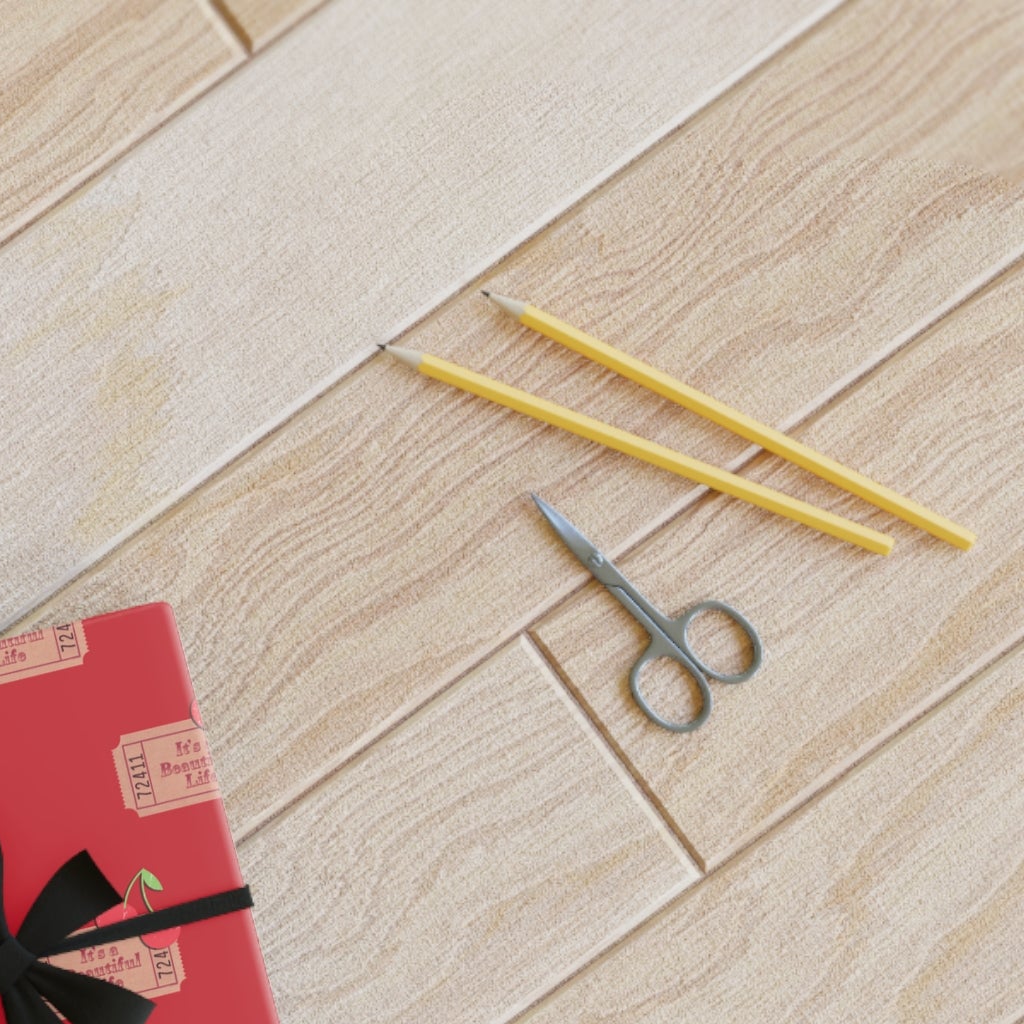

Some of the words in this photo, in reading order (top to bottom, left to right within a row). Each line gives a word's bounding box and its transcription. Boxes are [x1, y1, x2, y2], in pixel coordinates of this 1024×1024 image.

[175, 739, 201, 757] It's
[129, 753, 152, 800] 72411
[185, 769, 217, 789] Life
[80, 946, 106, 964] It's
[110, 945, 119, 957] a
[154, 950, 173, 980] 724
